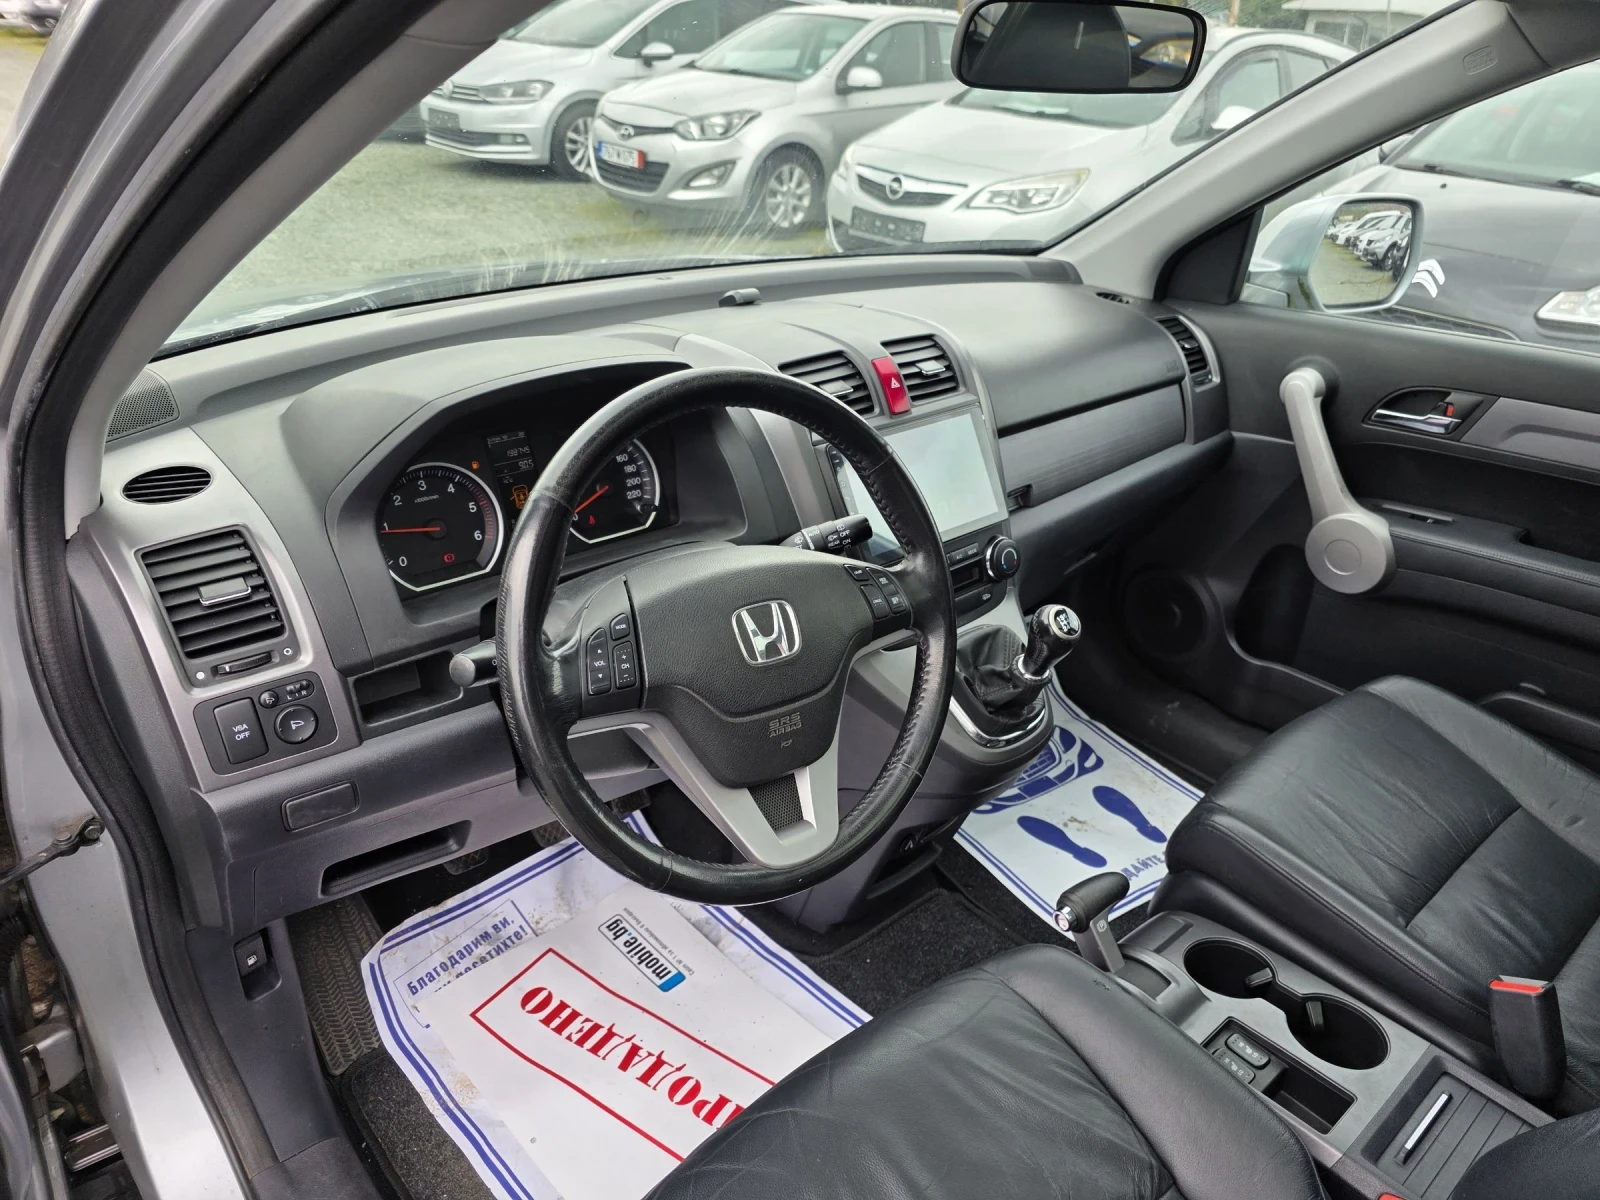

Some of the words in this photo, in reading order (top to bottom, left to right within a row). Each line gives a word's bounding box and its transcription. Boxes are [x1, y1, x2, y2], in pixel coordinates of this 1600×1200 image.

[616, 453, 629, 463] 160
[624, 464, 637, 473] 180
[417, 480, 427, 491] 3
[626, 477, 641, 487] 200
[447, 483, 456, 494] 4
[626, 489, 642, 500] 220
[393, 495, 403, 506] 2
[468, 502, 477, 513] 5
[474, 530, 483, 541] 6
[840, 529, 850, 538] OFF
[399, 556, 408, 567] 0
[769, 712, 801, 728] SRS
[232, 723, 249, 732] VSA
[768, 721, 802, 738] AIRBAG
[235, 731, 250, 741] OFF
[605, 918, 673, 981] mobile.bg
[406, 930, 493, 996] Благодарим
[491, 916, 516, 935] ви,
